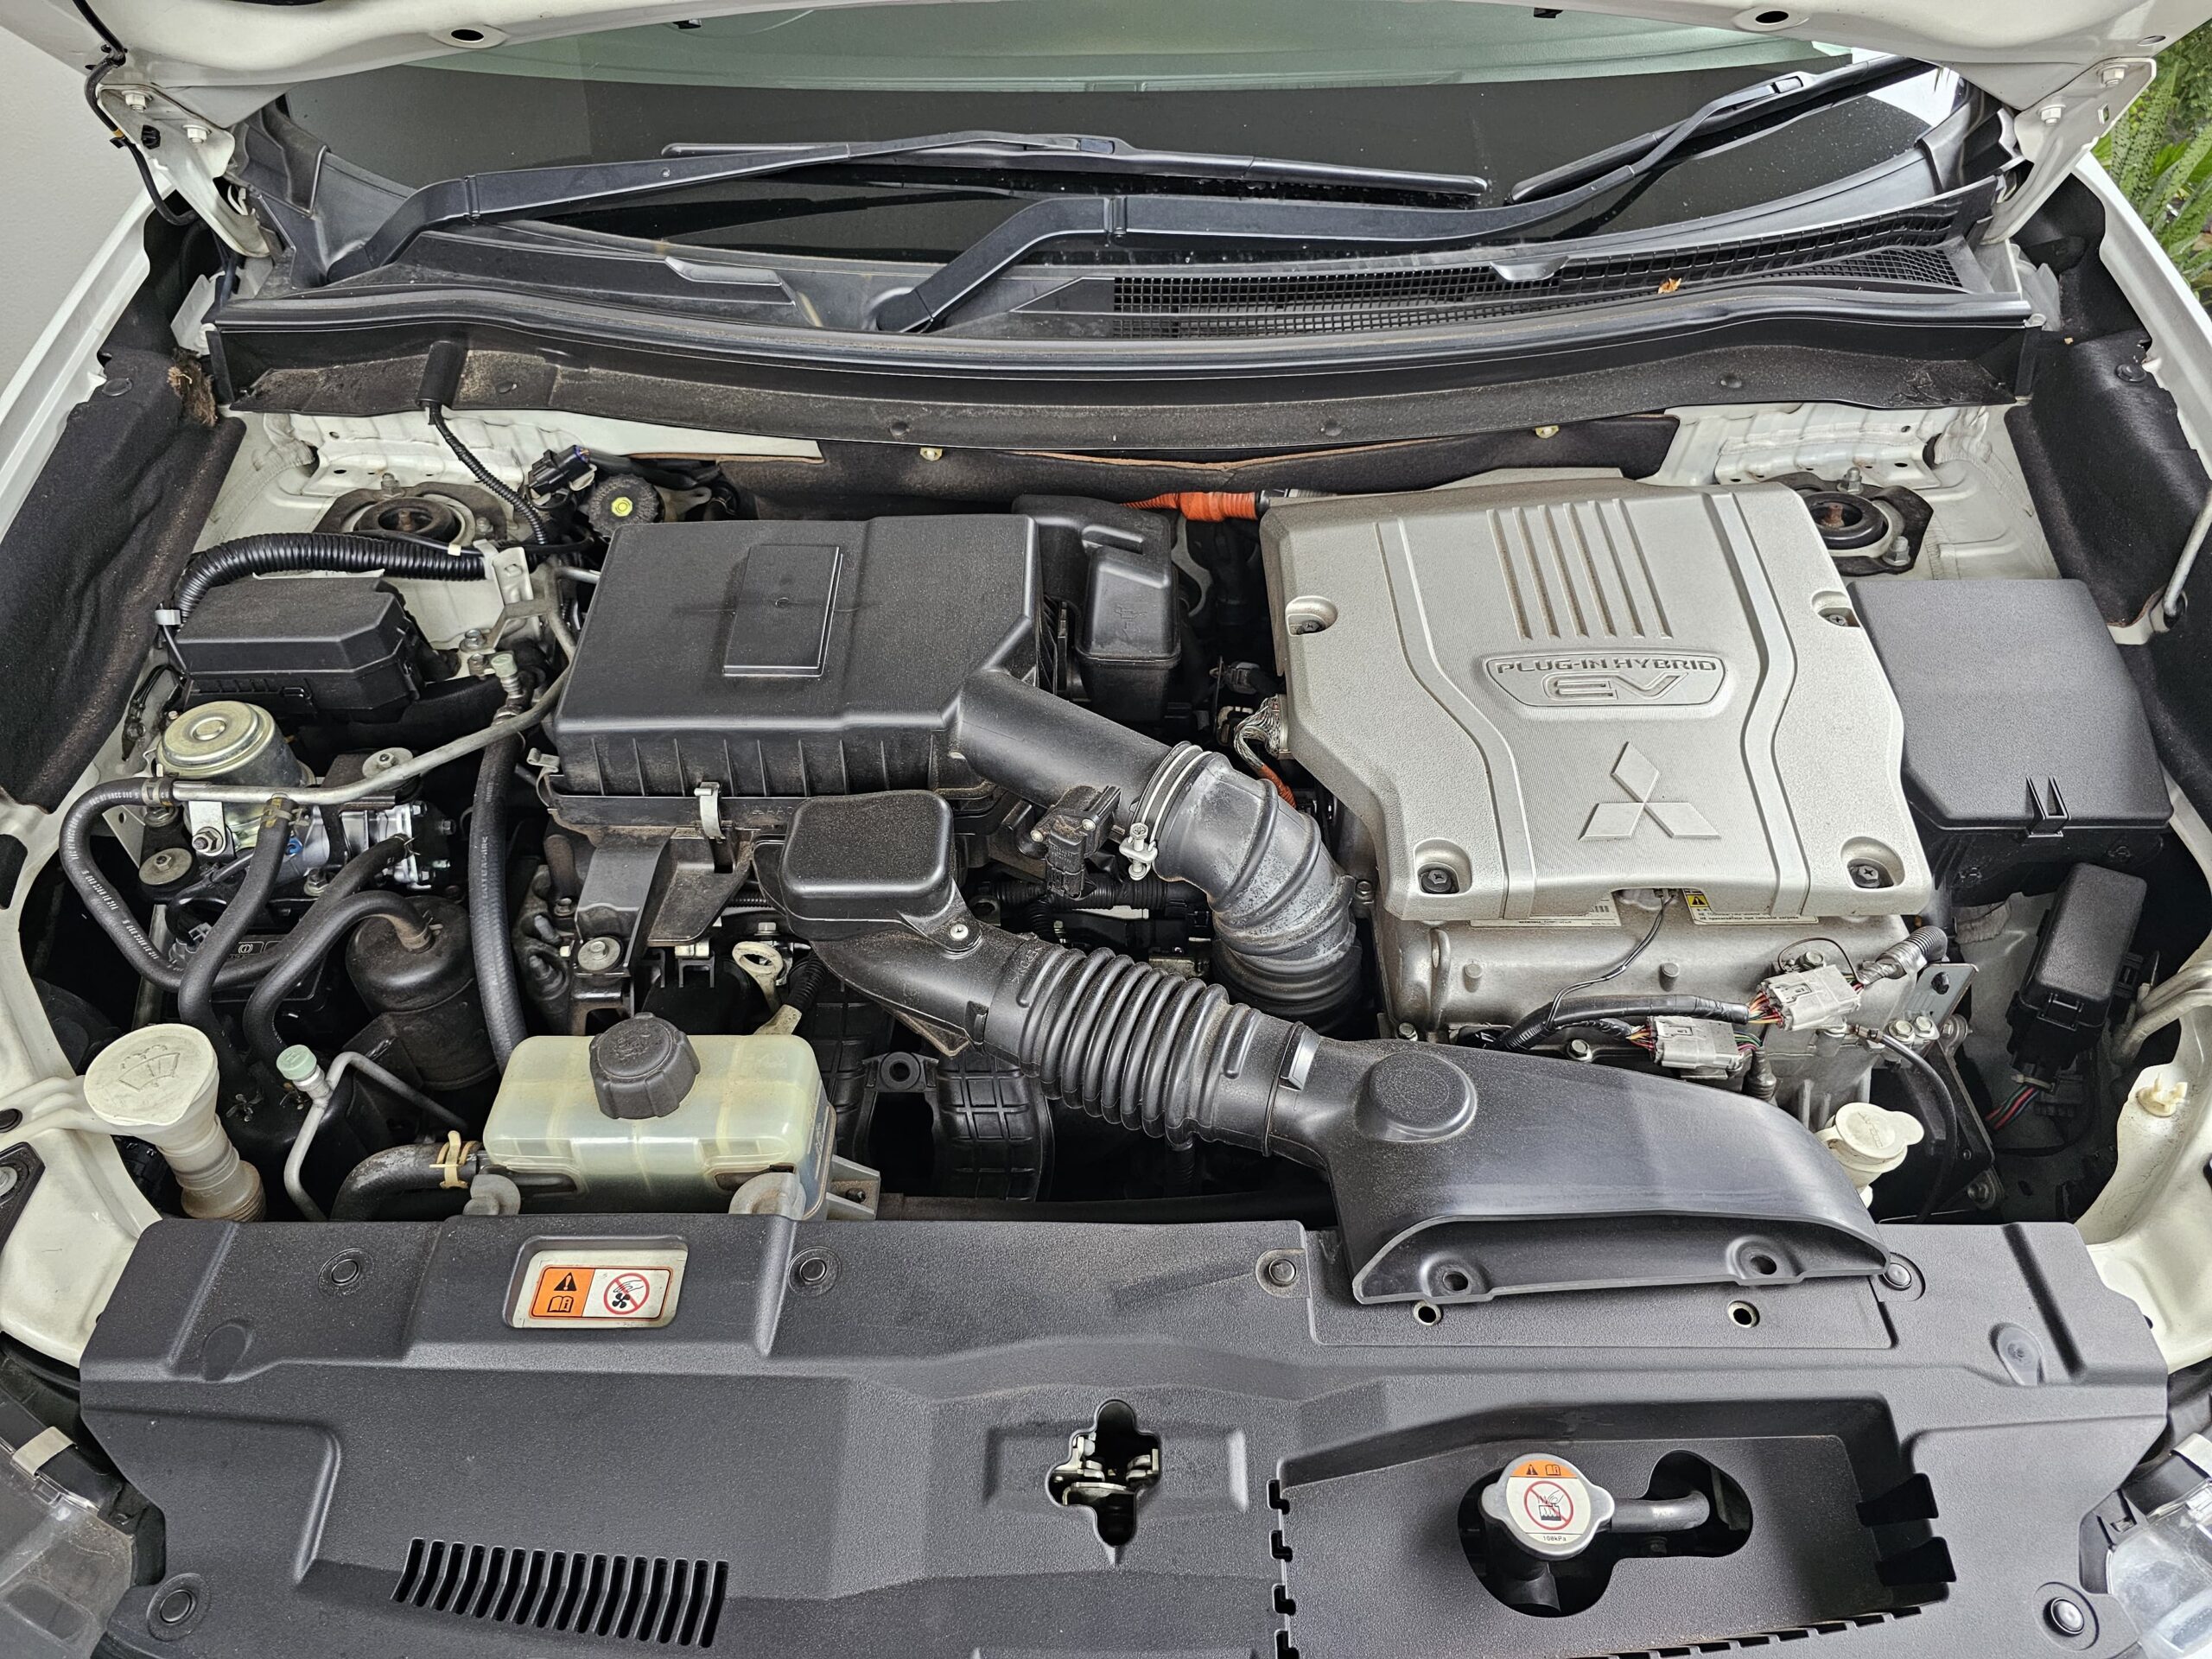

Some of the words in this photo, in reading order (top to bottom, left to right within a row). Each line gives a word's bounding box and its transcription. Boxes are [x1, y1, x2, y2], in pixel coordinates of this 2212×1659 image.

[1496, 658, 1608, 674] PLUG-IN
[1614, 658, 1717, 671] HYBRID
[1541, 671, 1689, 701] EV
